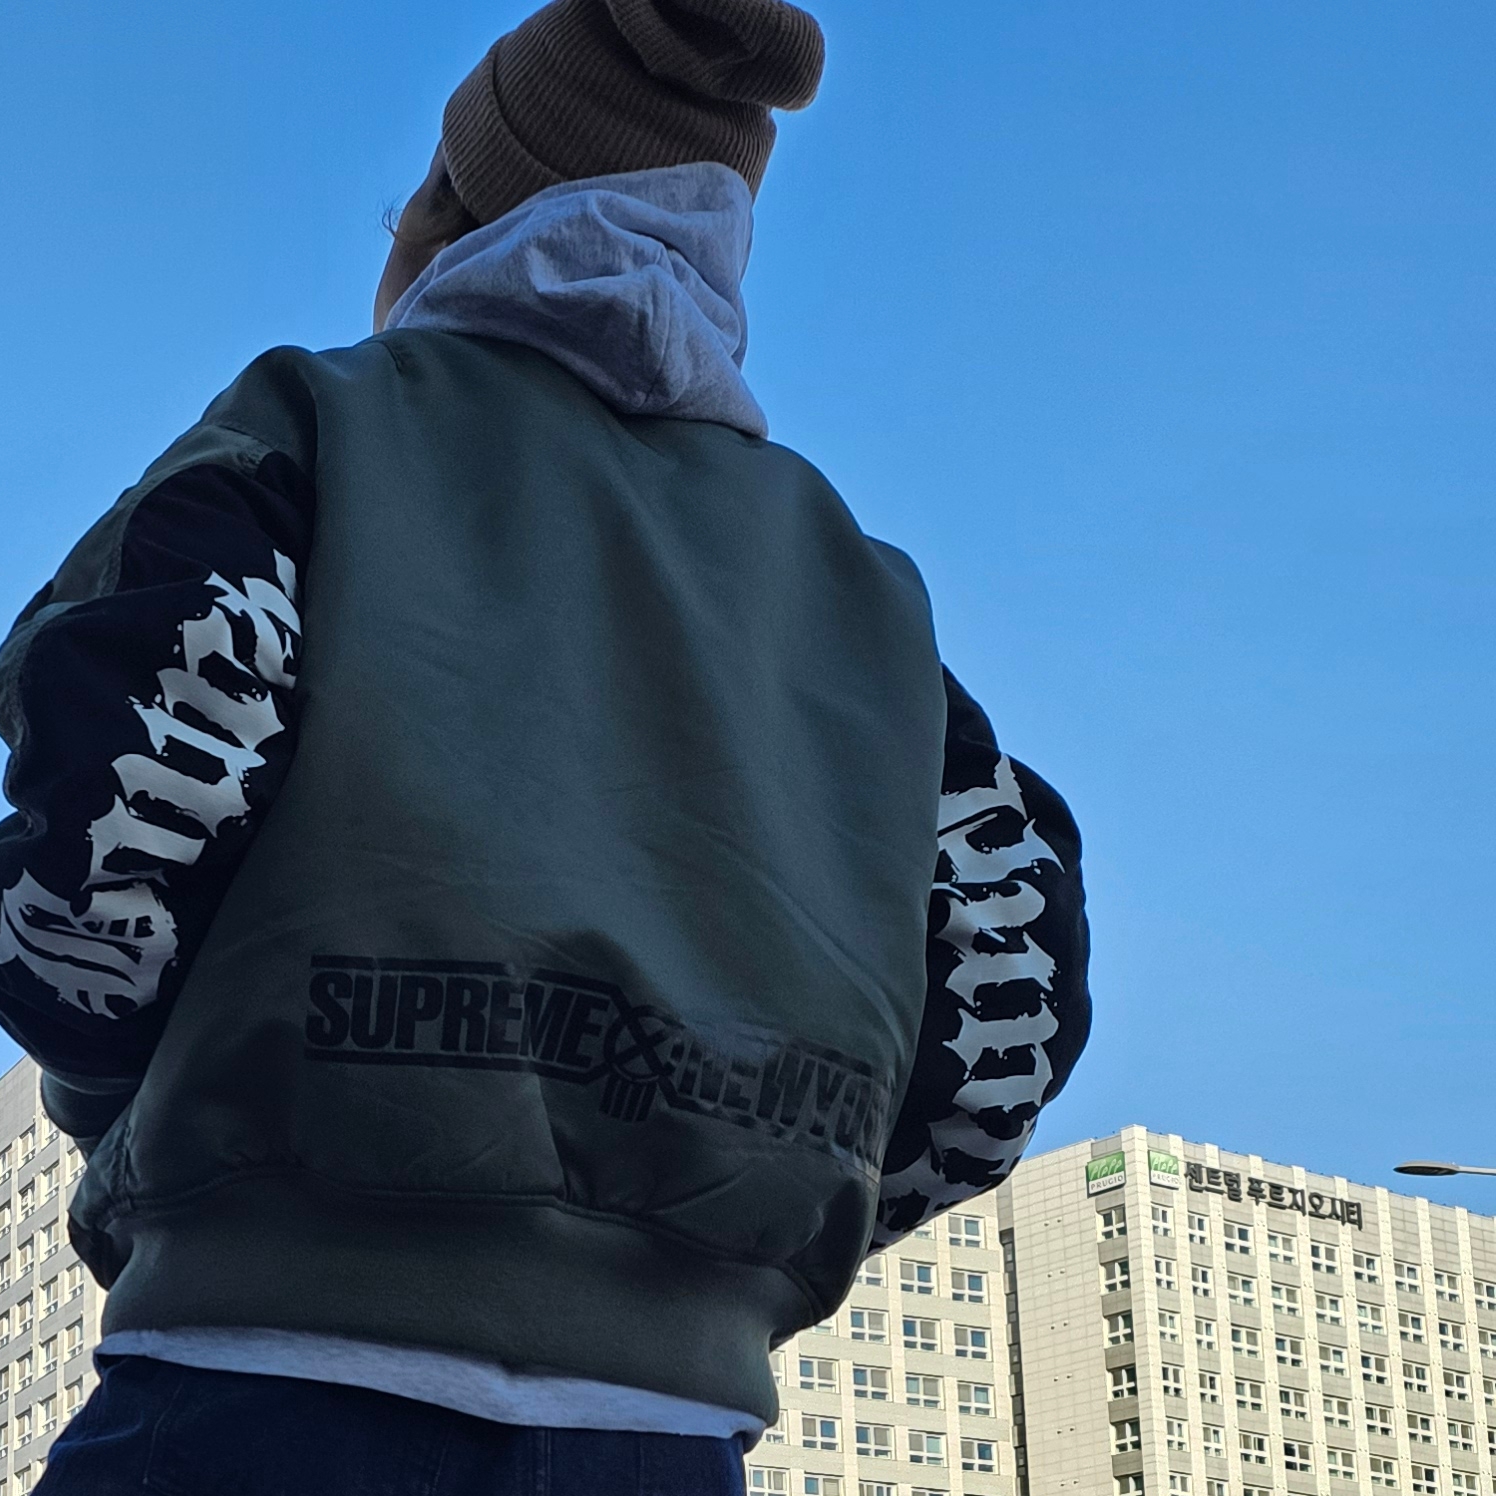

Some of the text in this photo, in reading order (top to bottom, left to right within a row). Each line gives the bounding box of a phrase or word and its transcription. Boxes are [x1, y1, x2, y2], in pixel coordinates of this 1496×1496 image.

[304, 970, 610, 1068] SUPREME
[1090, 1174, 1124, 1191] PRUGIO
[1185, 1161, 1363, 1231] 센트럴 푸르지오시티
